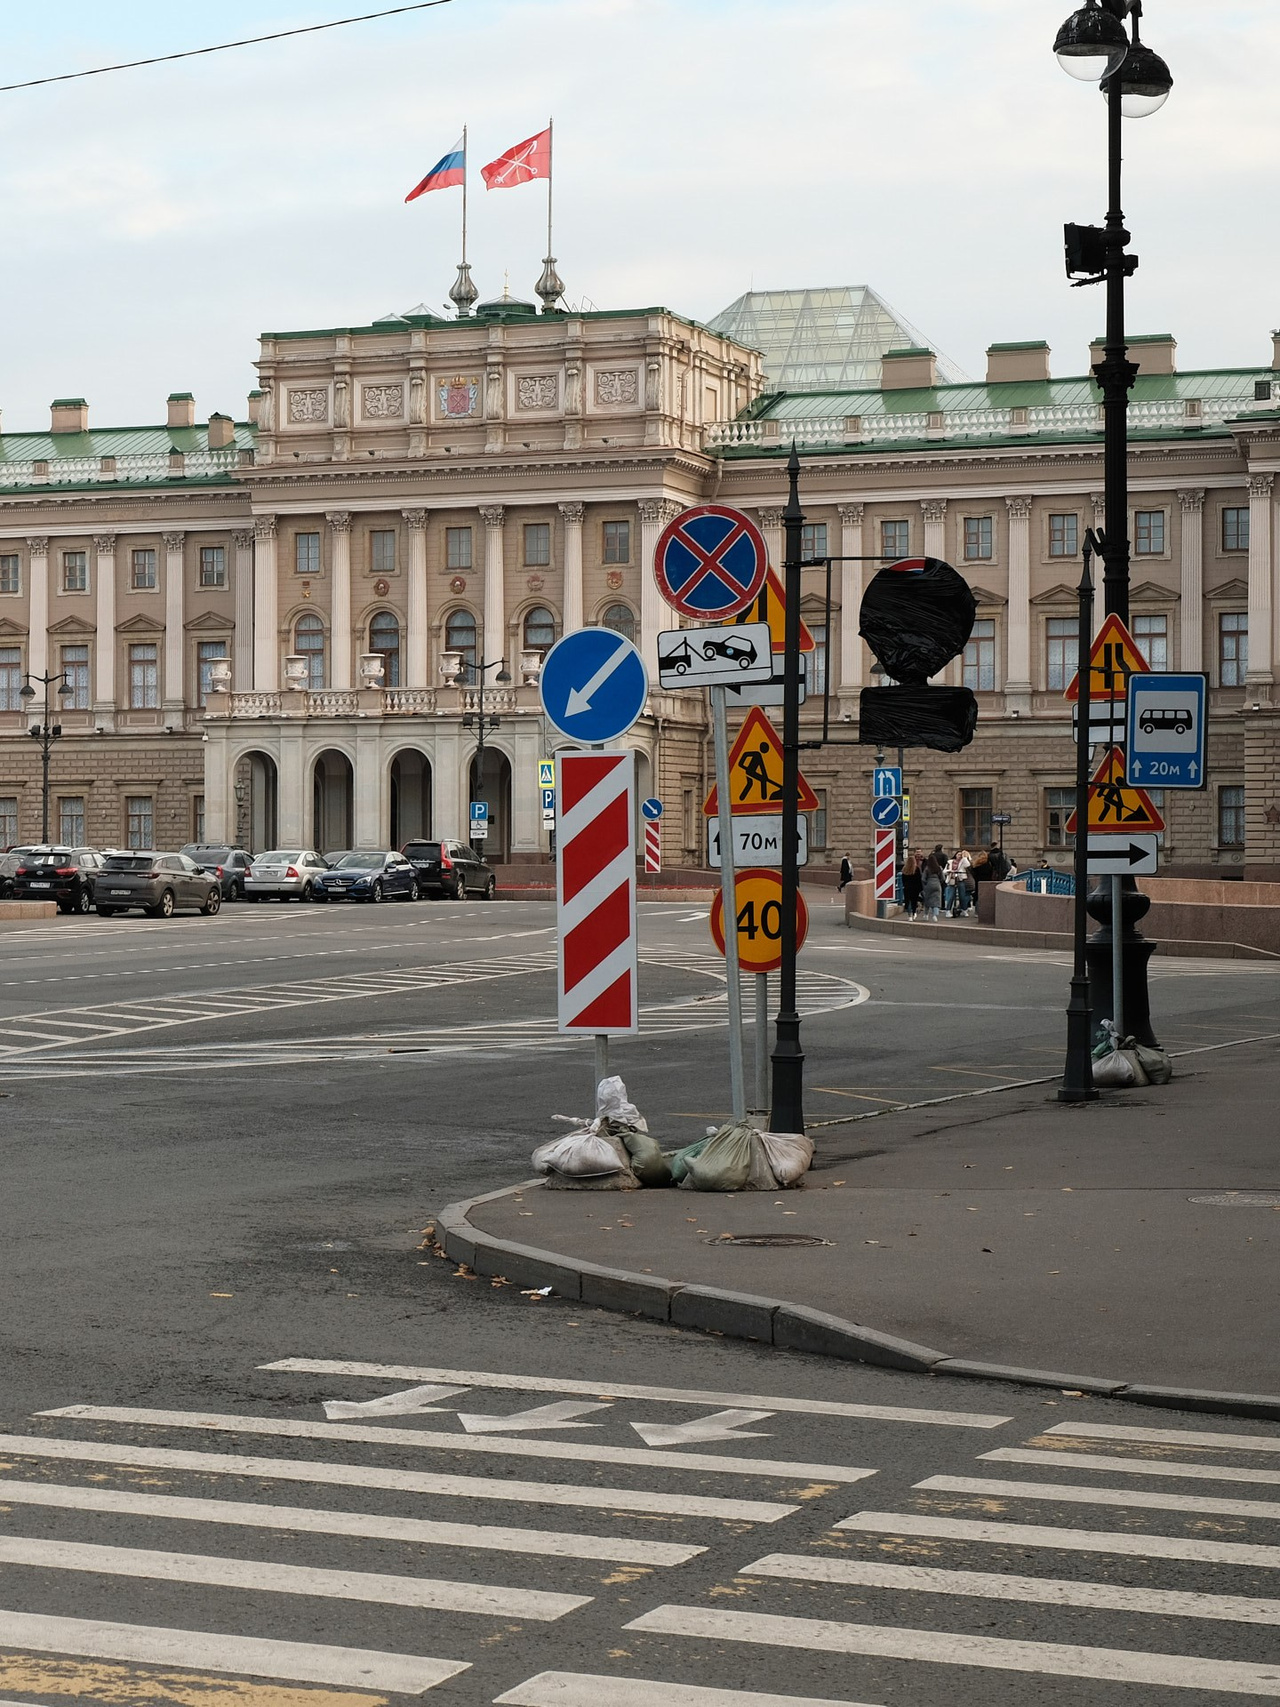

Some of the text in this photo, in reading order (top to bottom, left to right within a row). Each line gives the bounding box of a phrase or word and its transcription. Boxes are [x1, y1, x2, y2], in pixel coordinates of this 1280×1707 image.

[545, 792, 552, 807] P
[475, 804, 485, 818] P
[736, 900, 782, 940] 40
